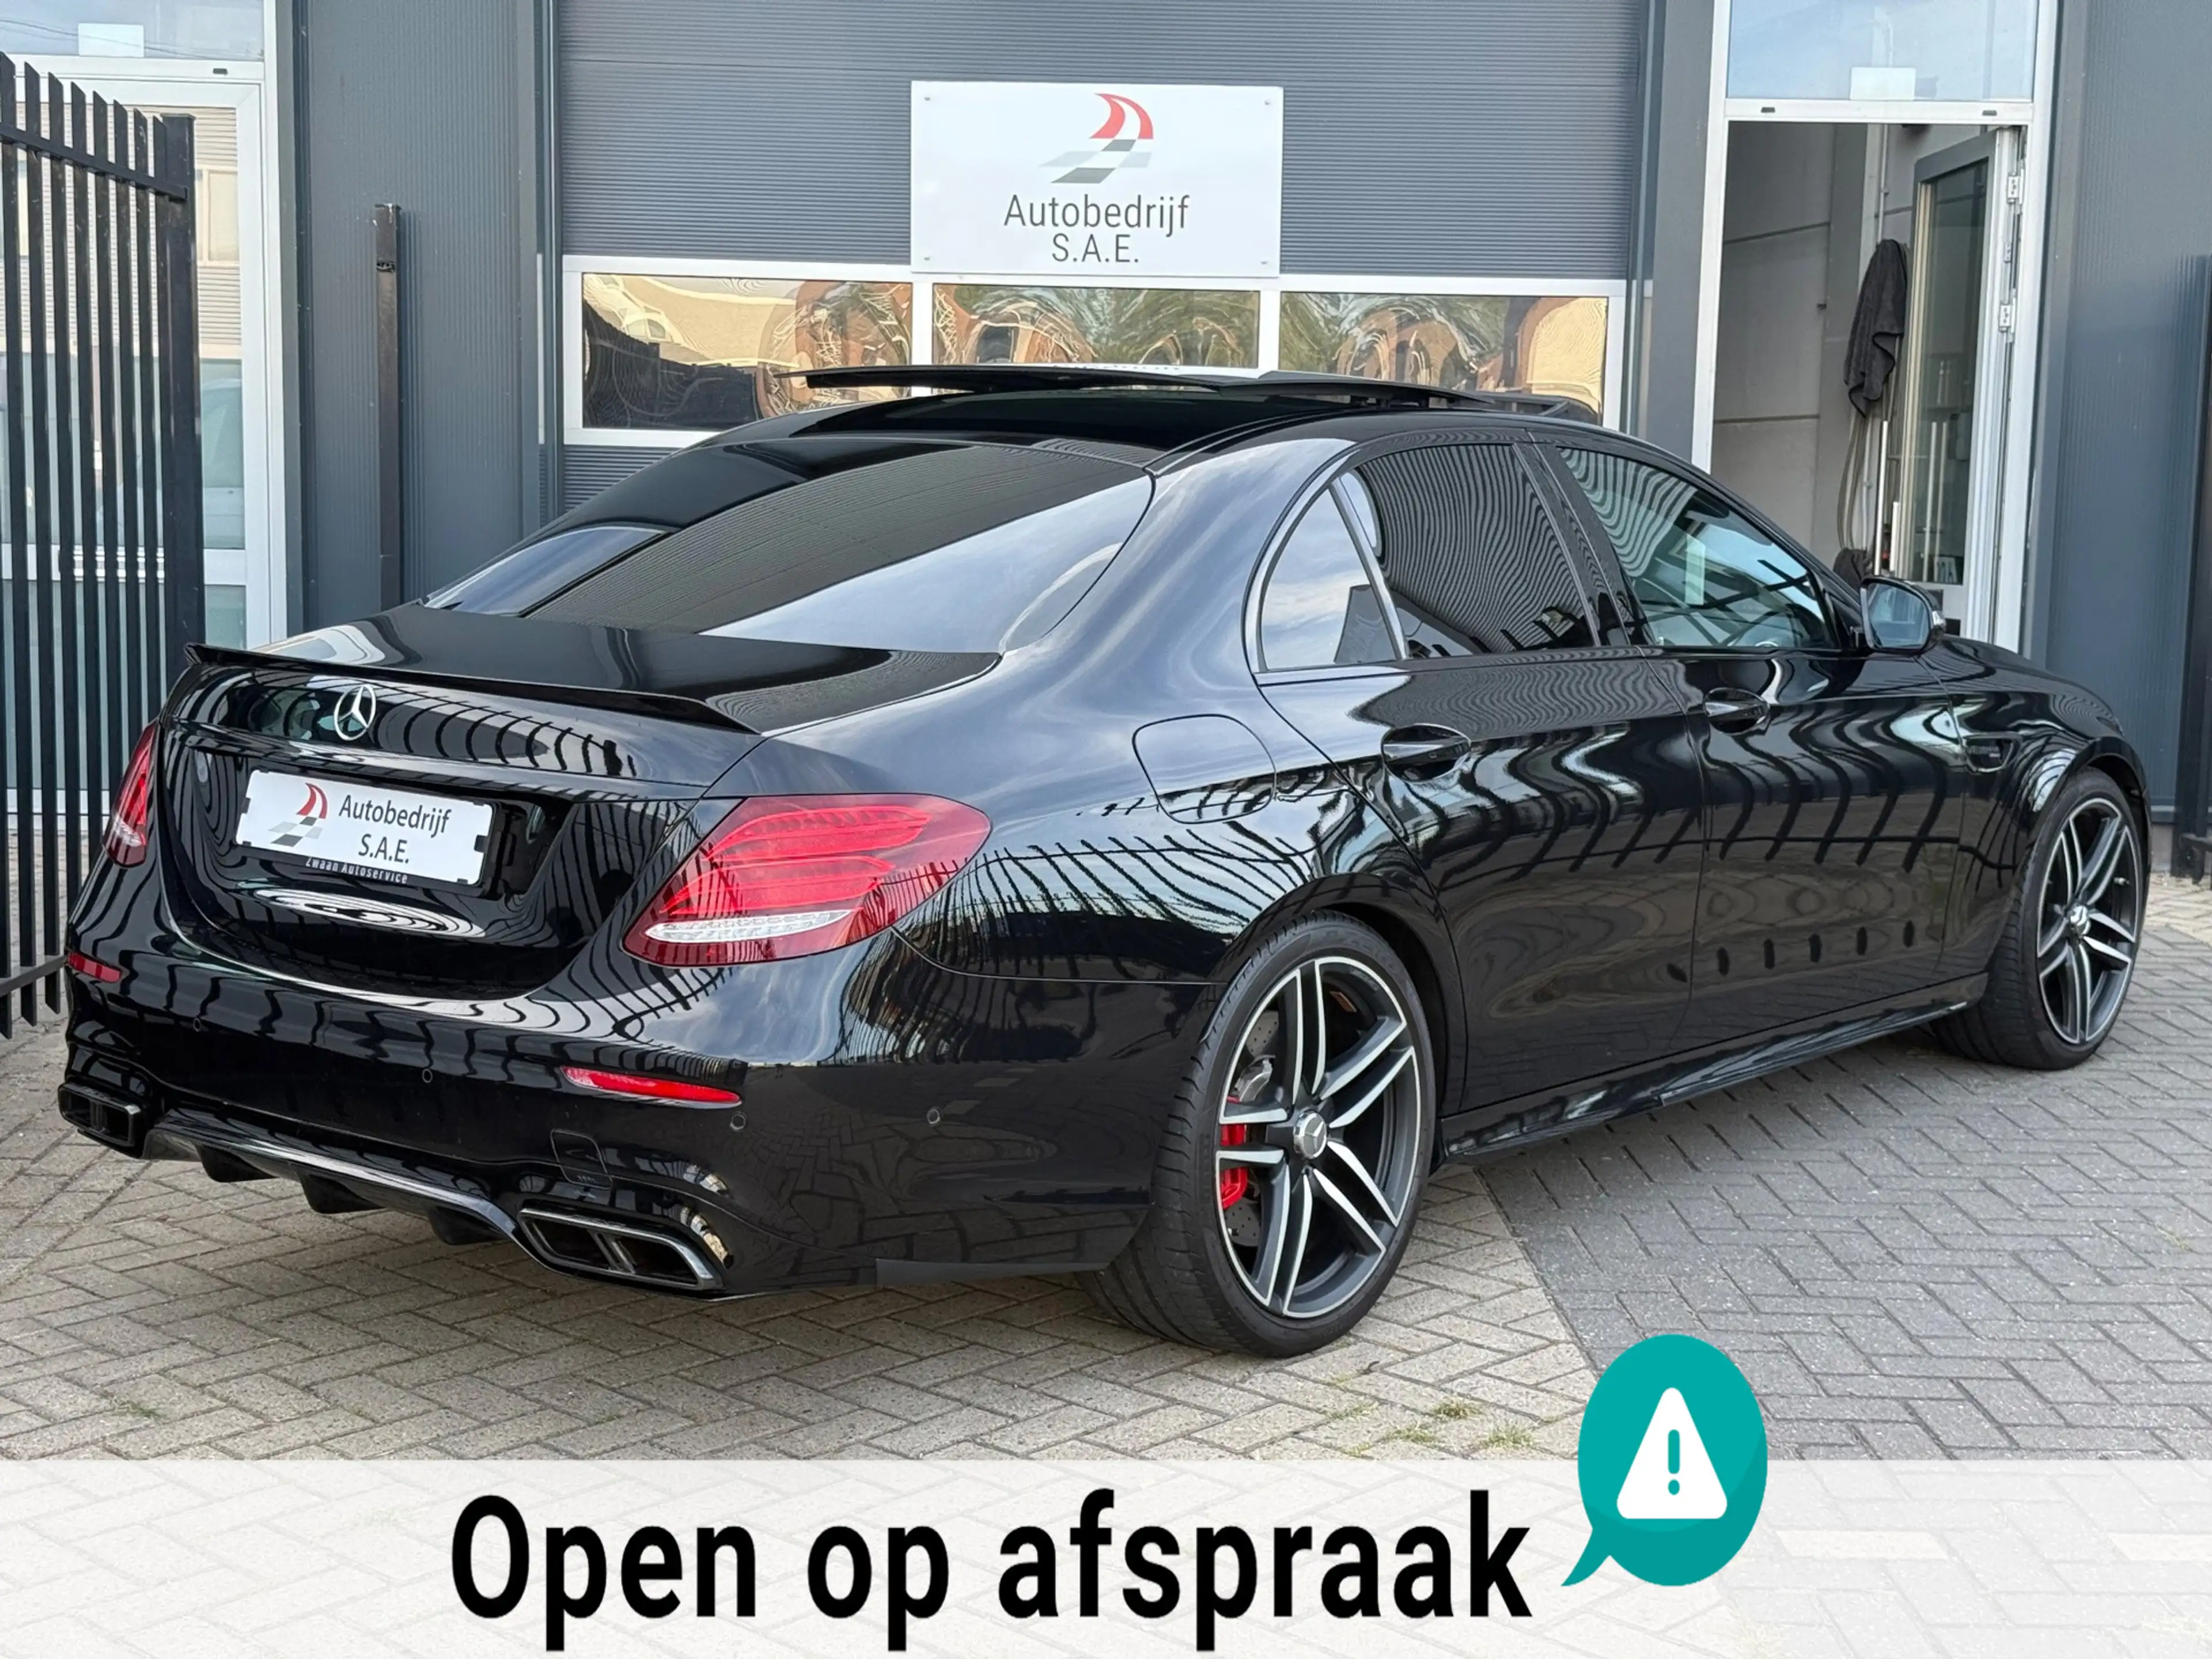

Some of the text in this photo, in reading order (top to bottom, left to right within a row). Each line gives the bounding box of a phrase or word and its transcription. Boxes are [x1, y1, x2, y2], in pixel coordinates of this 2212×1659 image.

[1003, 194, 1190, 238] Autobedrijf
[1052, 233, 1139, 263] S.A.E.
[338, 794, 452, 839] Autobedrijf
[358, 834, 410, 863] S.A.E.
[305, 857, 408, 884] Zwaan Autoservice
